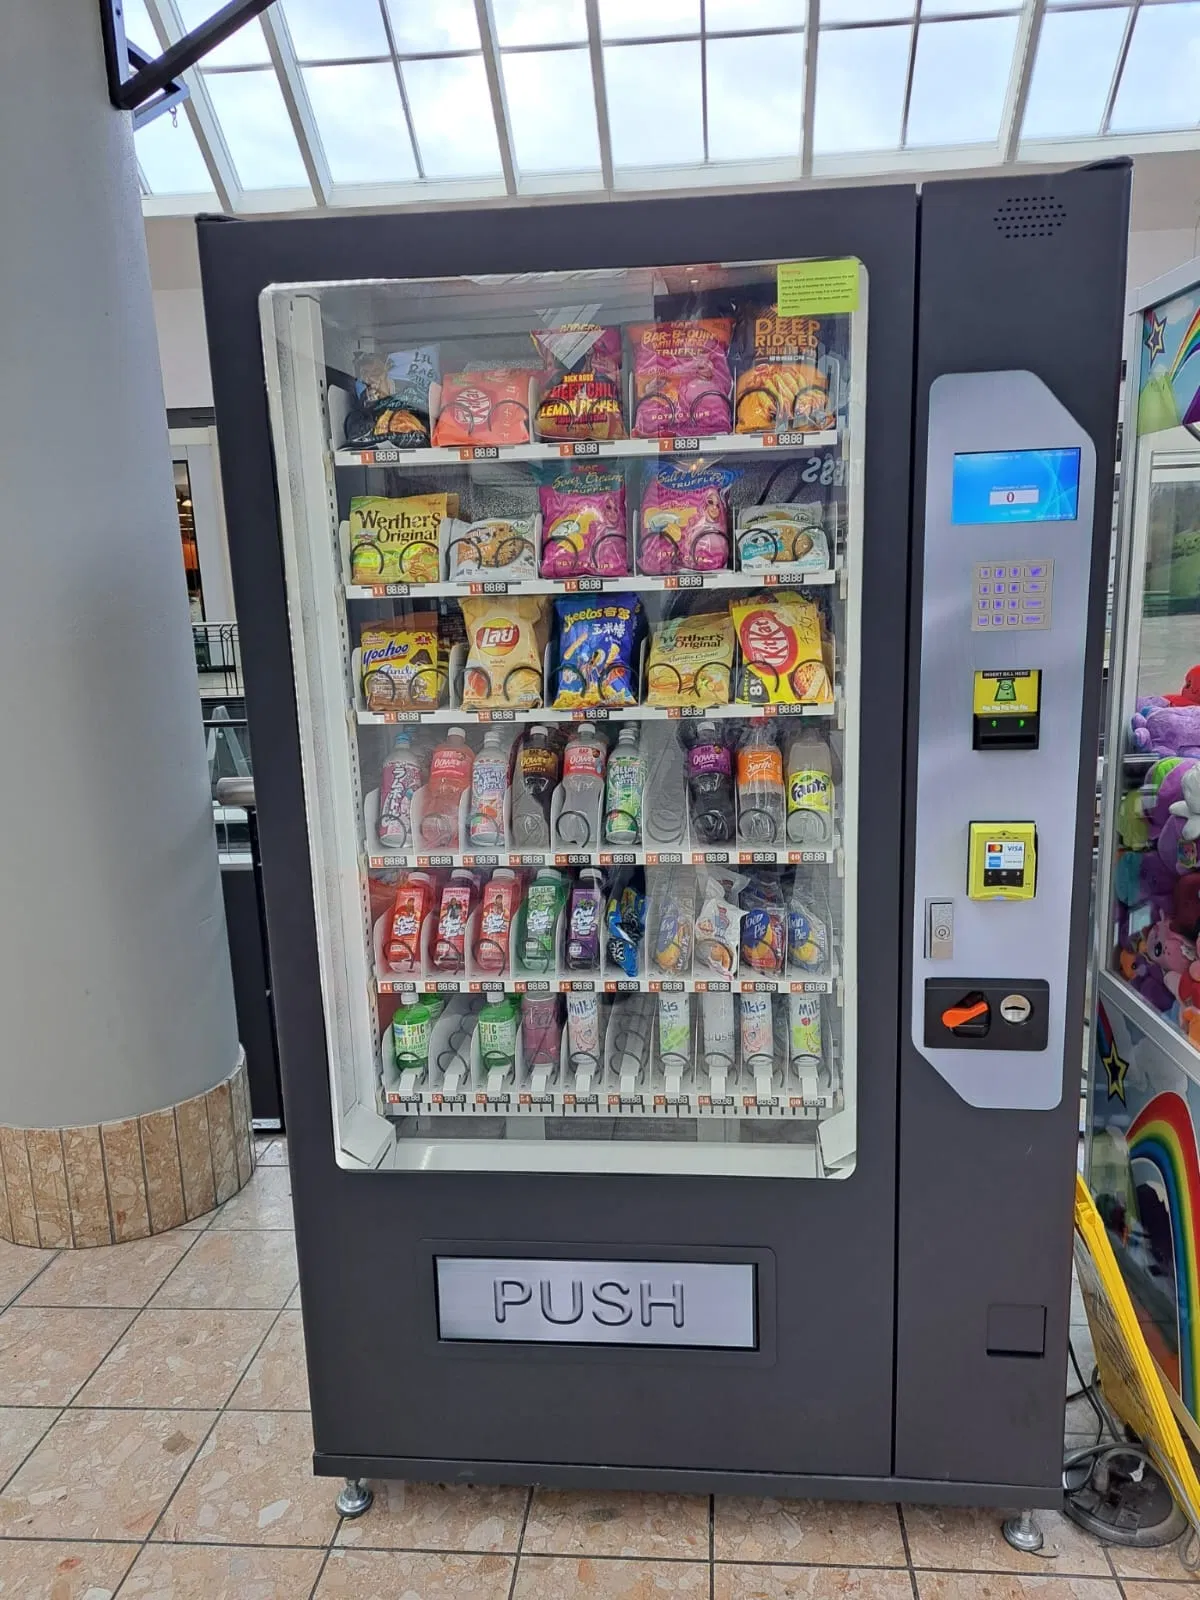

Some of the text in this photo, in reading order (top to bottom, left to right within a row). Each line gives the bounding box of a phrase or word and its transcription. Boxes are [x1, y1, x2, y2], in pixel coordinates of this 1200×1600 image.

[756, 319, 820, 336] DEEP
[756, 335, 818, 349] RIDGED
[779, 434, 802, 444] 88.88
[675, 439, 698, 449] 88.88
[475, 448, 497, 458] 88.88
[575, 444, 598, 454] 88.88
[376, 452, 398, 462] 88.88
[1006, 491, 1015, 503] 0
[377, 525, 438, 546] Original
[667, 577, 702, 587] 17 88.88
[766, 574, 803, 583] 19 88.88
[472, 582, 506, 592] 13 88.88
[566, 579, 602, 589] 15 88.88
[374, 584, 409, 594] 11 88.88
[677, 642, 723, 654] Original
[586, 710, 608, 718] 88.88
[779, 705, 801, 714] 88.88
[398, 713, 420, 721] 88.88
[492, 711, 514, 720] 88.88
[791, 779, 827, 802] Fanta
[372, 857, 406, 866] 31 88.88
[418, 855, 452, 865] 32 88.88
[464, 855, 498, 865] 33 88.88
[510, 855, 544, 865] 34 88.88
[556, 854, 590, 864] 35 88.88
[602, 854, 634, 863] 36 88.88
[647, 854, 681, 863] 37 88.88
[693, 854, 728, 863] 38 88.88
[741, 853, 775, 862] 39 88.88
[789, 853, 826, 862] 40 88.88
[393, 983, 414, 992] 88.88
[438, 983, 458, 991] 88.88
[482, 982, 503, 991] 88.88
[528, 982, 548, 990] 88.88
[573, 982, 593, 990] 88.88
[618, 982, 639, 990] 88.88
[663, 982, 683, 991] 88.88
[709, 983, 730, 991] 88.88
[755, 982, 777, 991] 88.88
[804, 983, 826, 992] 88.88
[493, 1279, 685, 1328] PUSH
